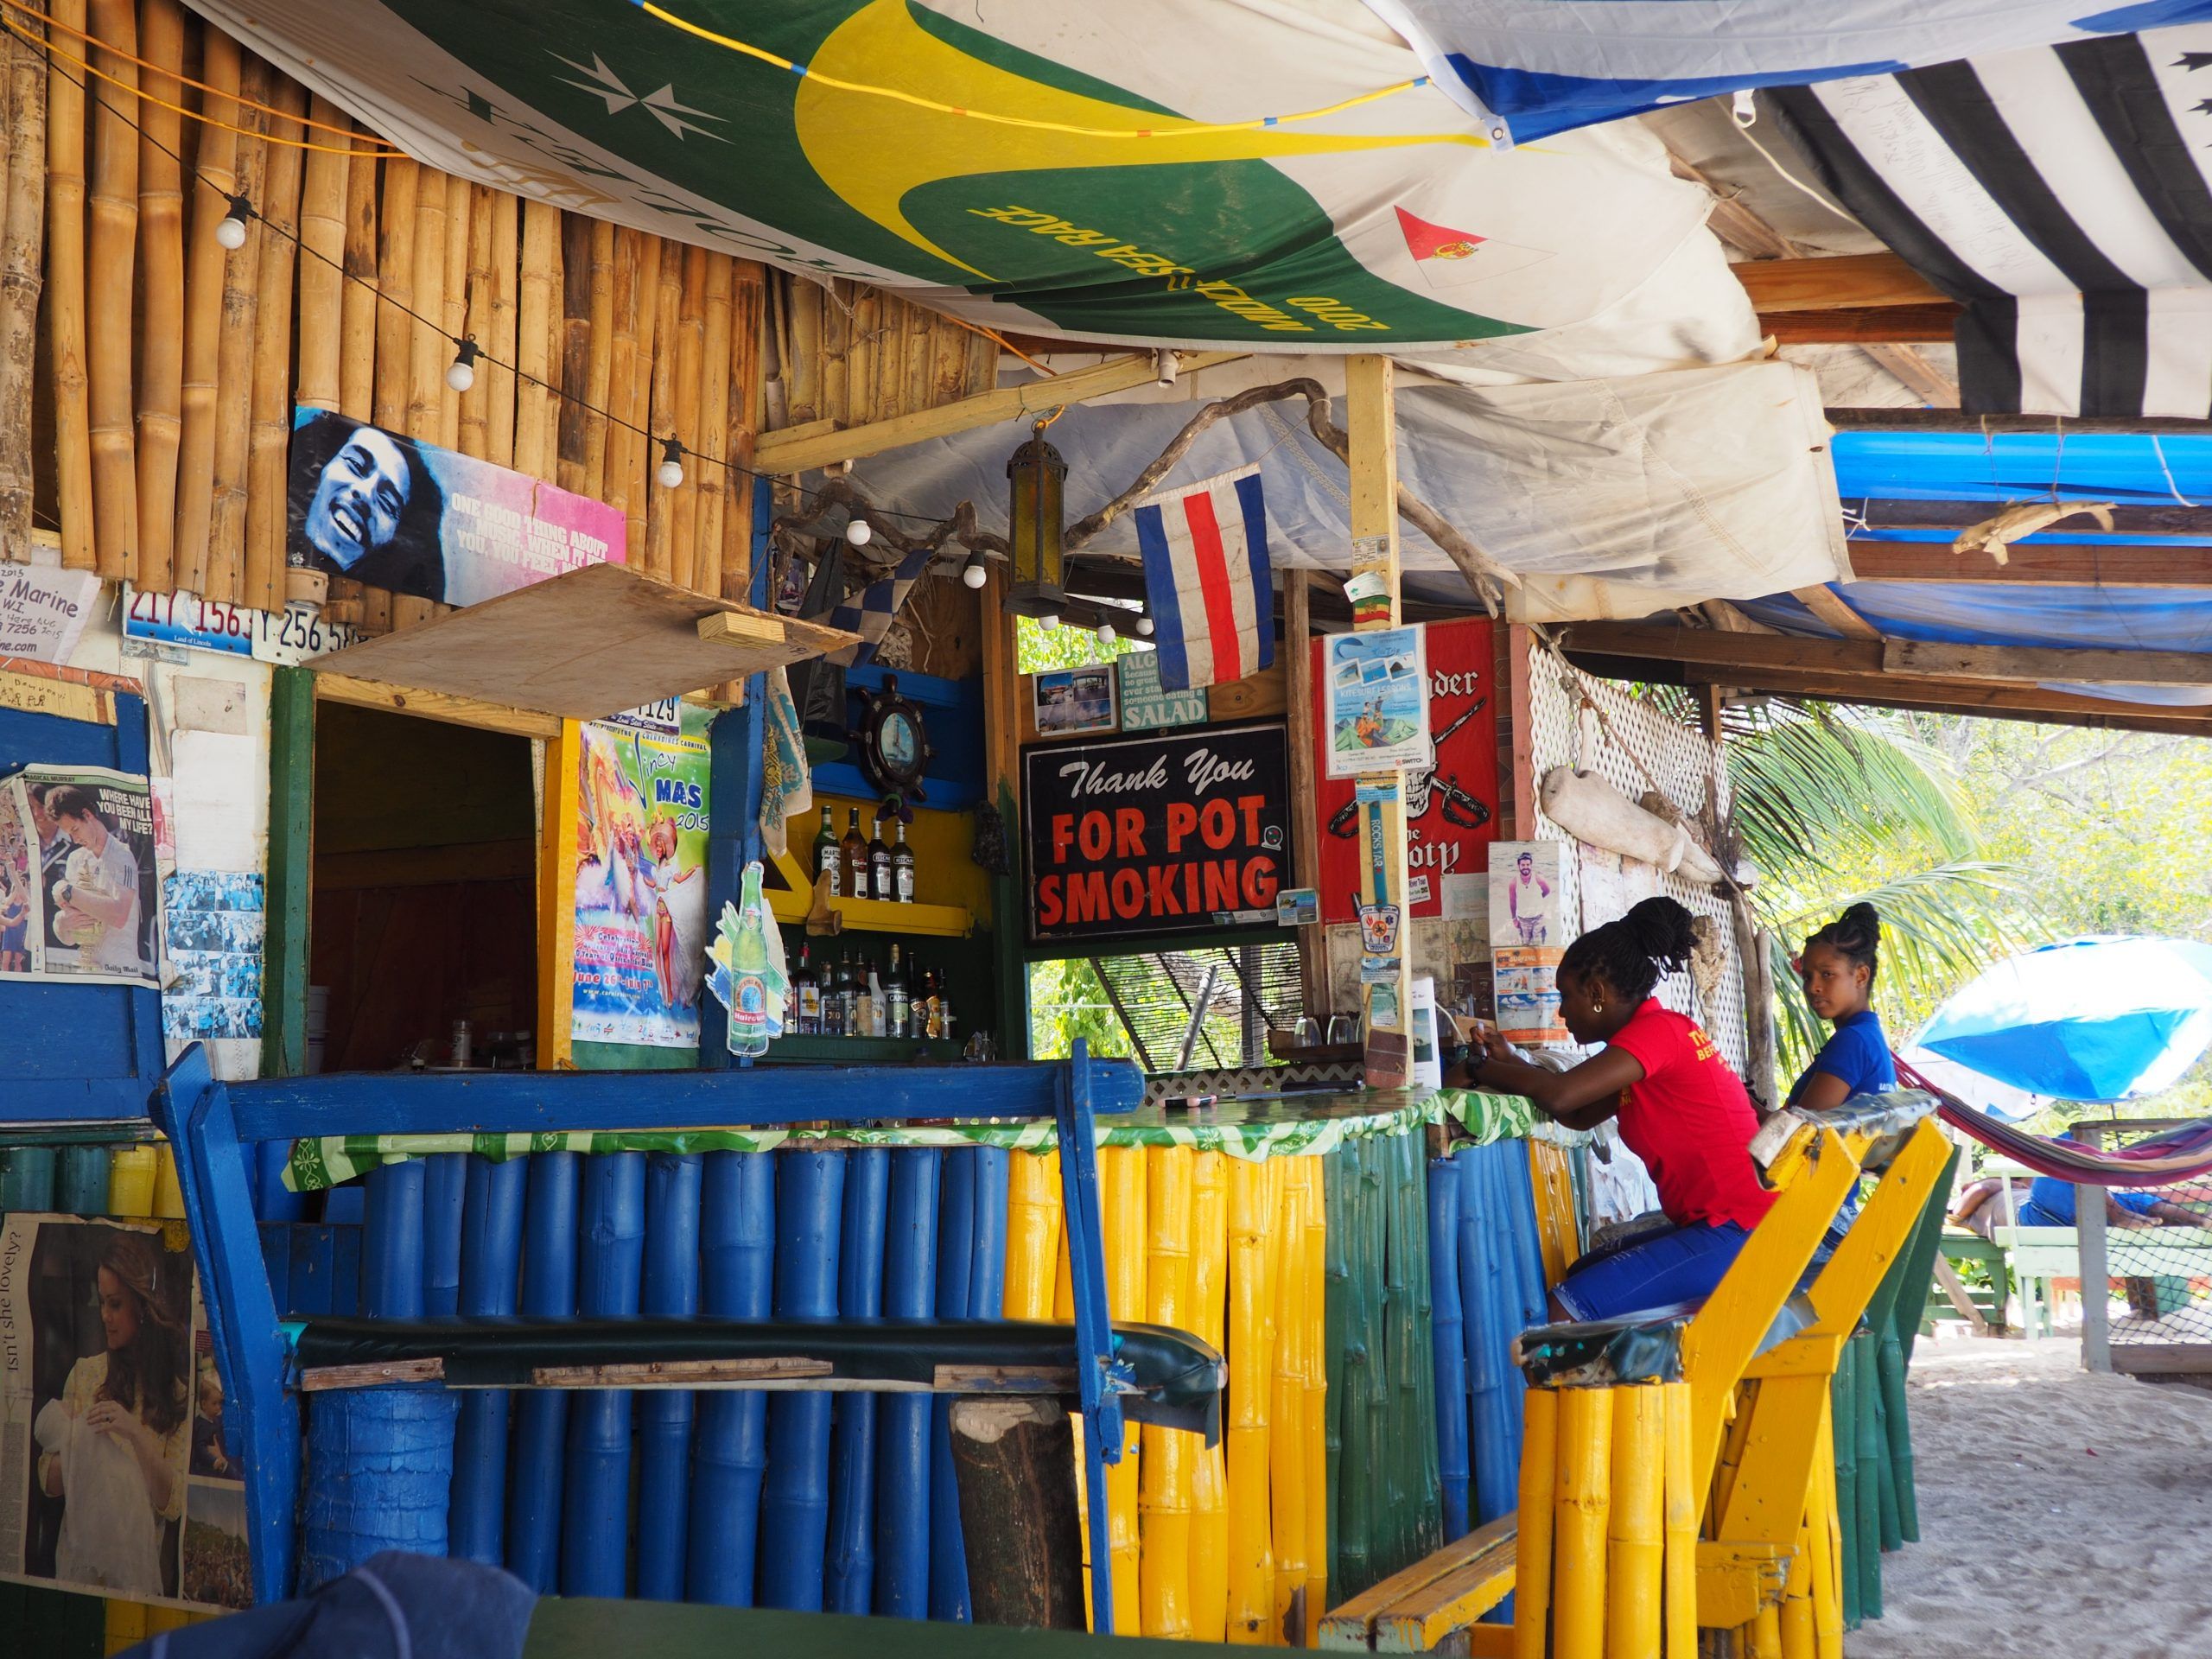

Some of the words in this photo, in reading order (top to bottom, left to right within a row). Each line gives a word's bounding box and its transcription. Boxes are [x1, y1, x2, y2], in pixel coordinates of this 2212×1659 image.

[966, 206, 1120, 245] RACE
[1094, 245, 1195, 276] SEA
[1286, 296, 1391, 331] 2010
[452, 493, 481, 518] ONE
[483, 503, 521, 530] GOOD
[524, 516, 567, 543] THING
[570, 531, 608, 559] ABOUT
[493, 541, 518, 564] YOU
[522, 550, 558, 575] FEEL
[527, 535, 569, 562] WHEN
[571, 548, 584, 568] IT
[9, 579, 78, 618] Marine
[7, 623, 37, 635] 7256
[280, 609, 321, 652] 256
[1125, 698, 1205, 728] SALAD
[680, 740, 707, 751] CARNIVAL
[1059, 754, 1167, 798] Thank
[1184, 748, 1255, 795] You
[99, 788, 129, 804] WHERE
[129, 794, 151, 809] HAVE
[655, 779, 702, 809] MAS
[97, 801, 116, 813] YOU
[117, 804, 136, 817] BEEN
[137, 809, 152, 821] ALL
[119, 817, 132, 830] MY
[132, 822, 153, 835] LIFE?
[676, 811, 709, 831] 2015
[1052, 808, 1147, 863] FOR
[1166, 795, 1265, 853] POT
[1039, 856, 1278, 925] SMOKING
[105, 964, 121, 974] Daily
[573, 969, 600, 983] June
[0, 1298, 15, 1330] she
[3, 1334, 18, 1372] Isn't
